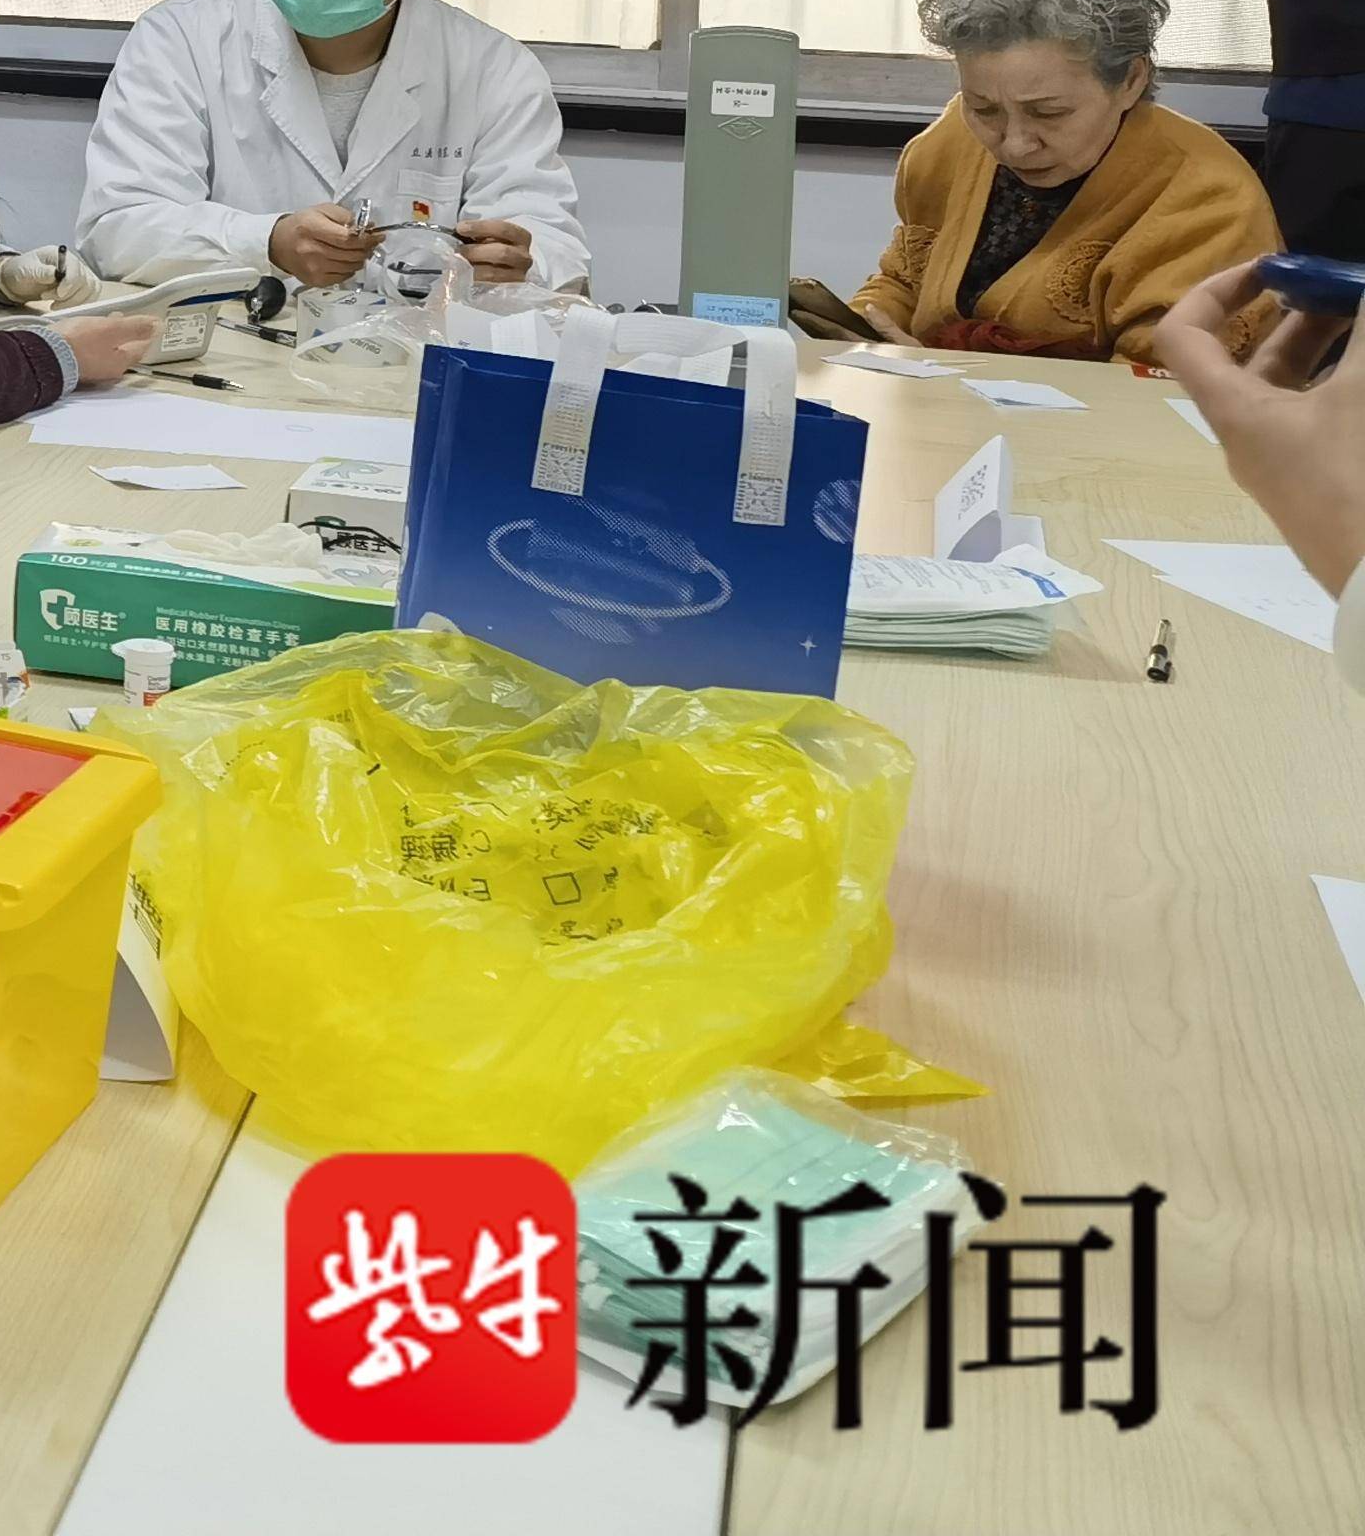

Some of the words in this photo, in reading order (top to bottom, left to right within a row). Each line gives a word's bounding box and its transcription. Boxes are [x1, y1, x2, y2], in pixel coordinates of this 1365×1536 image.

[155, 616, 300, 647] 医用橡胶检查手套
